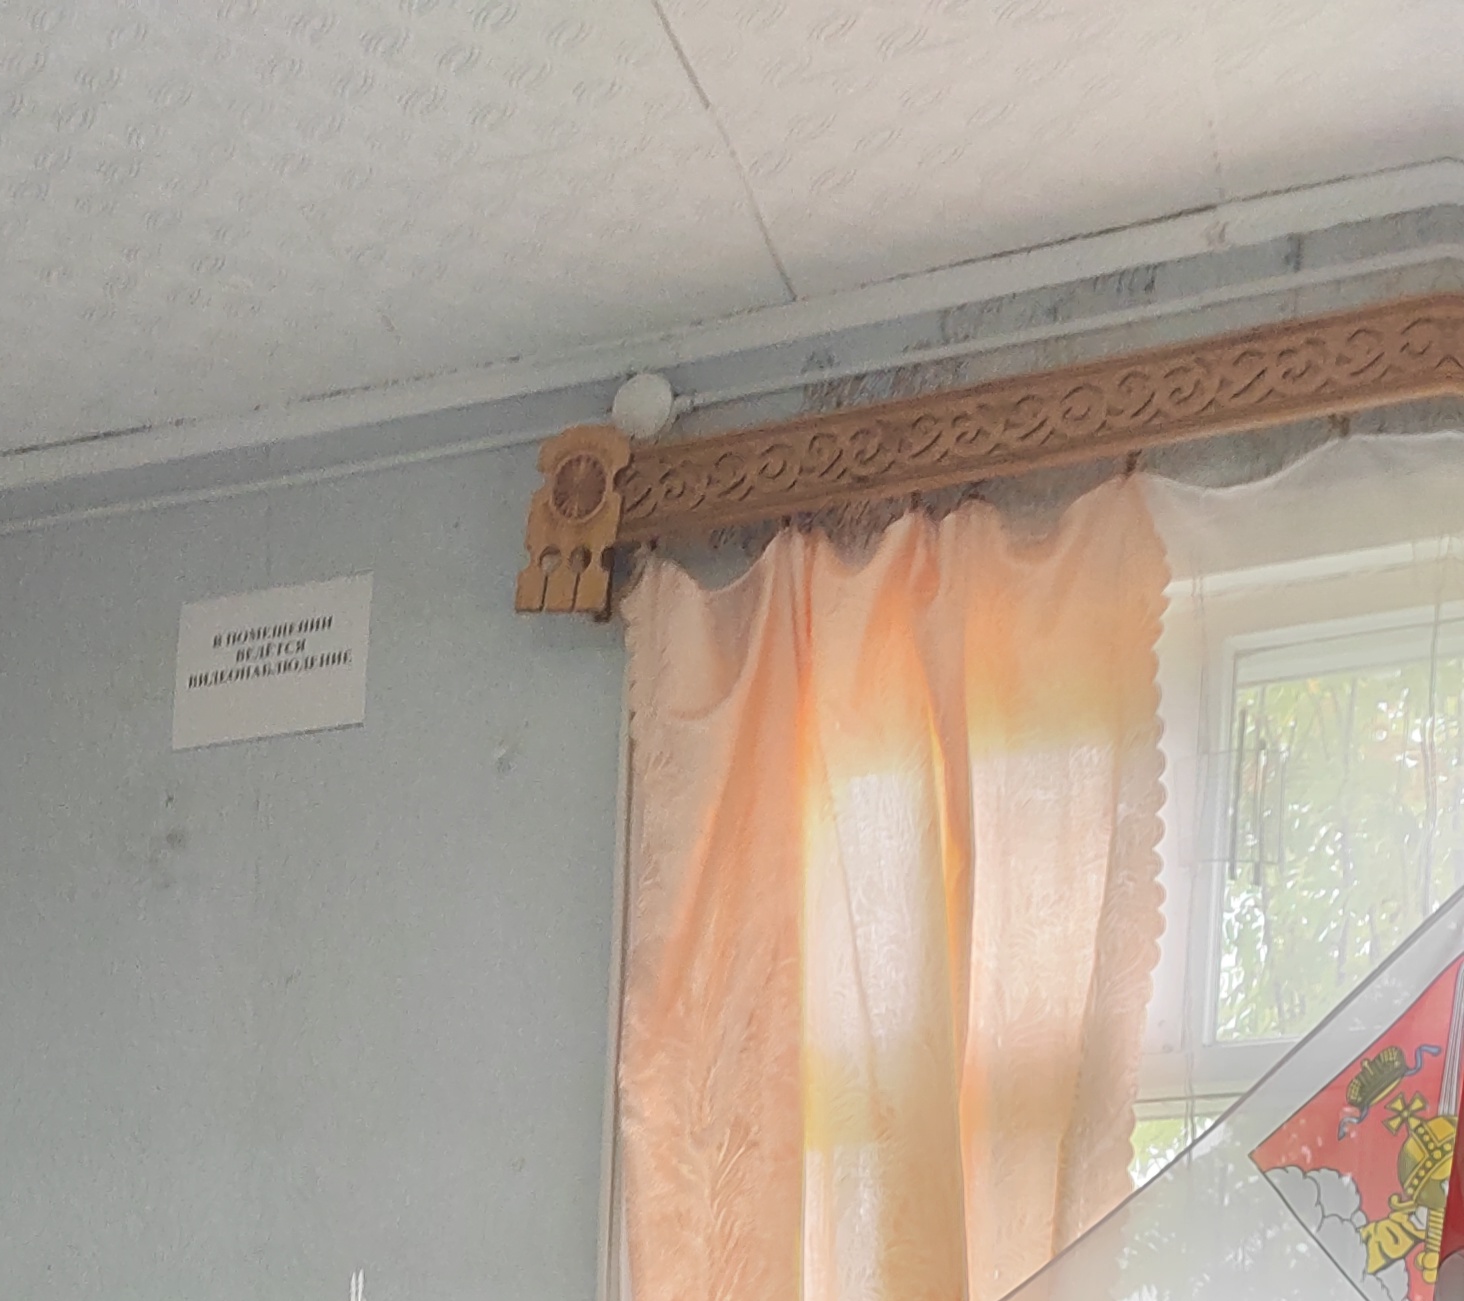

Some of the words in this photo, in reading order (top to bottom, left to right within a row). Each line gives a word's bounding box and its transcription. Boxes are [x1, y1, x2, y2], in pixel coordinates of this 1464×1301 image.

[212, 633, 222, 649] В
[226, 615, 334, 647] ПОМЕЩЕНИИ
[187, 649, 353, 689] ВИДЕОНАБЛЮДЕНИЕ
